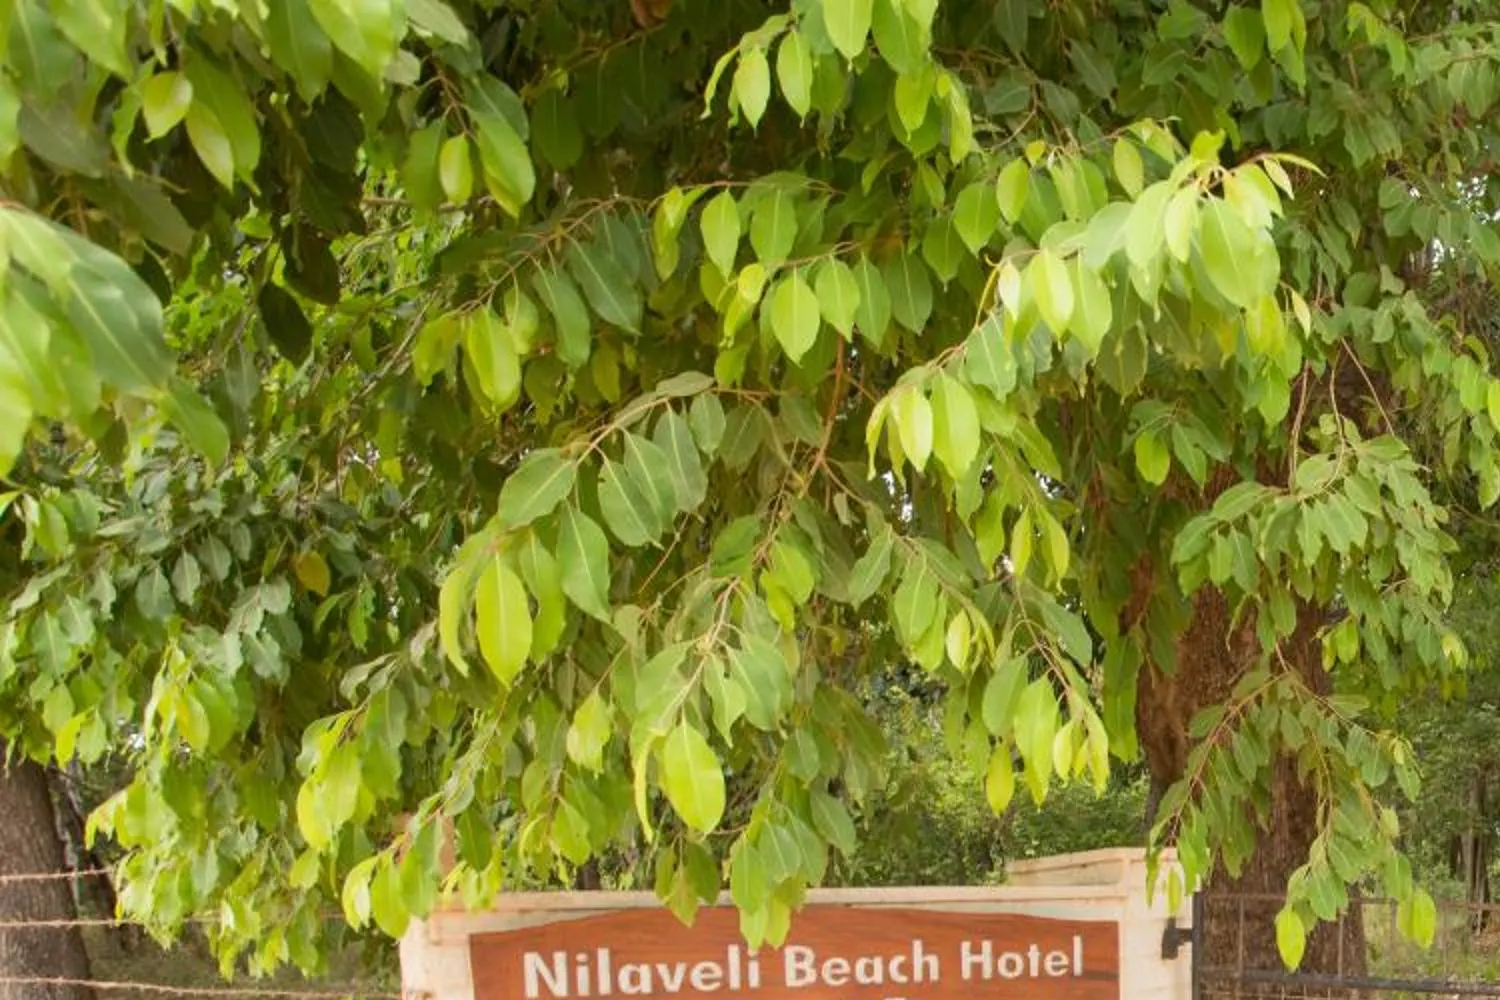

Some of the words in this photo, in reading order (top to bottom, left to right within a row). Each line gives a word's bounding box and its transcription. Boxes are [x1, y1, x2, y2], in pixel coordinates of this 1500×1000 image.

[522, 944, 761, 999] Nilaveli
[783, 939, 940, 988] Beach
[960, 935, 1083, 980] Hotel
